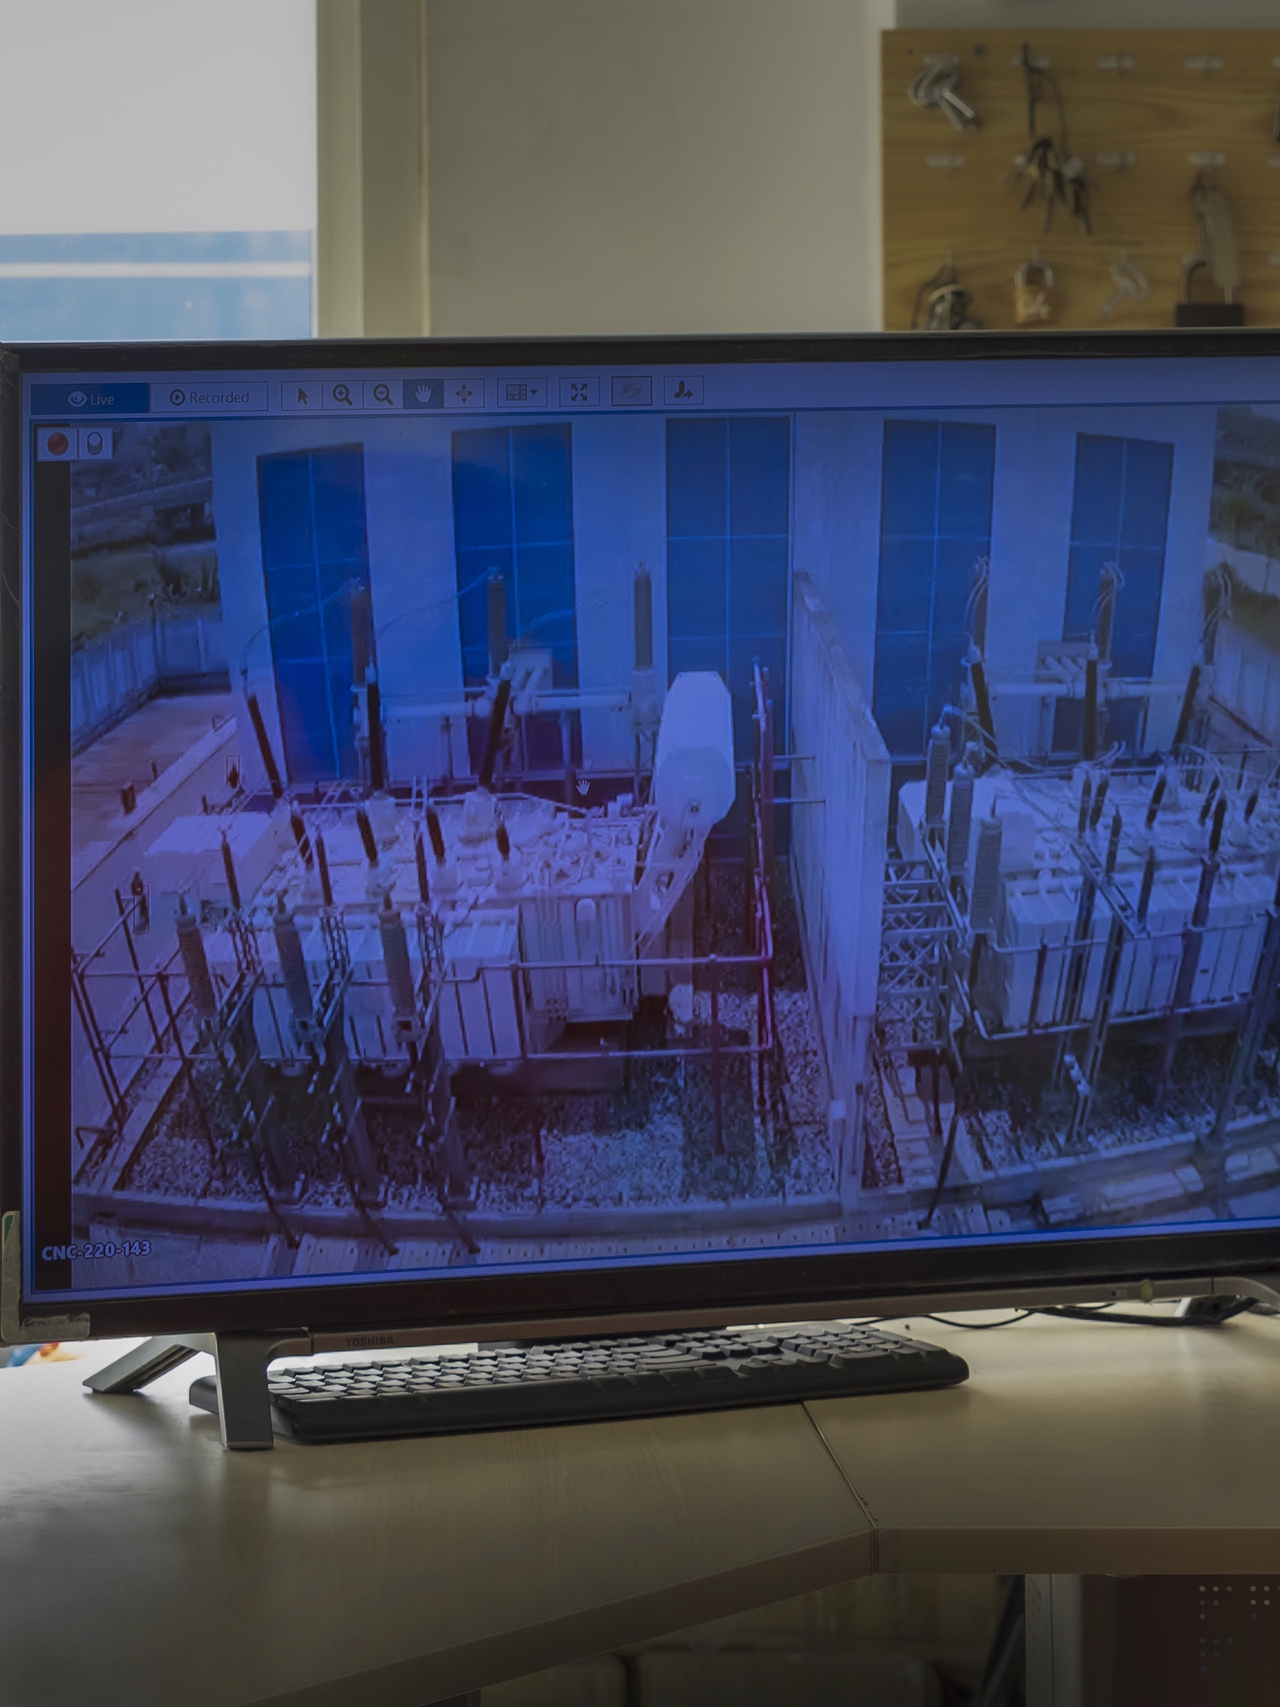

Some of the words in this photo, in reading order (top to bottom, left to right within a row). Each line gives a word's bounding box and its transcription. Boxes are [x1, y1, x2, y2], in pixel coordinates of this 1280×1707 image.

[90, 392, 116, 407] Live
[189, 390, 251, 405] Recorded
[41, 1240, 152, 1261] CNC-220-143
[345, 1335, 395, 1347] TOSHIBA
